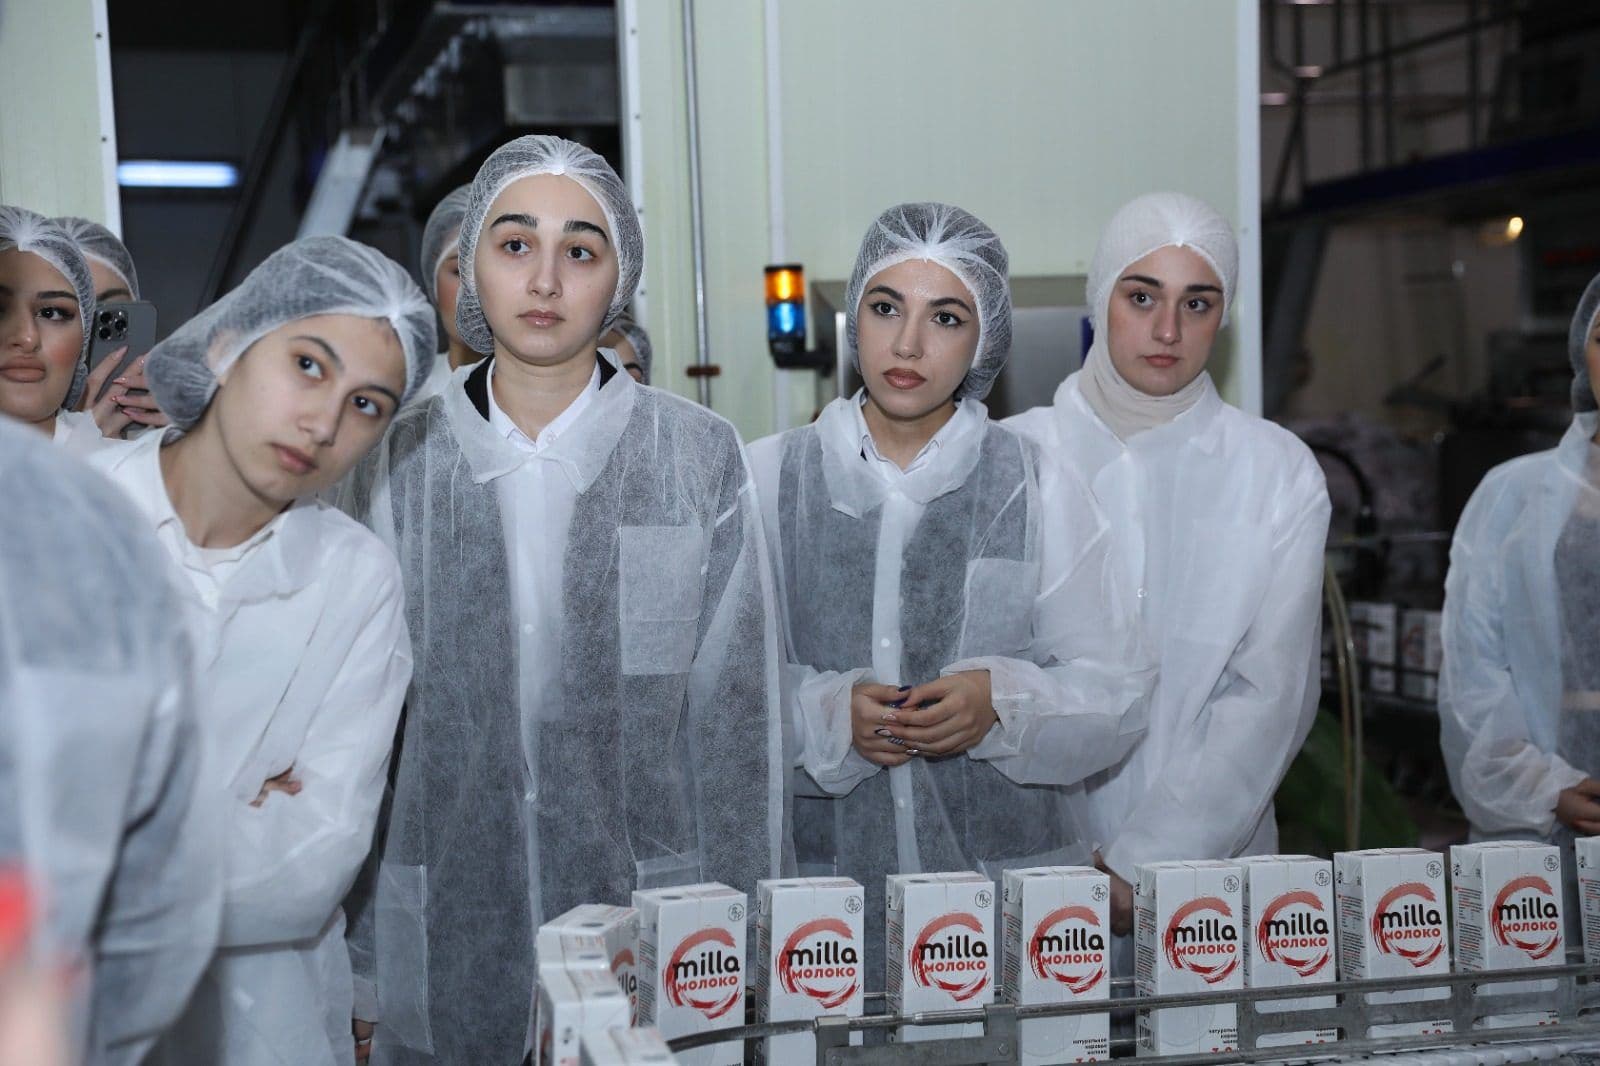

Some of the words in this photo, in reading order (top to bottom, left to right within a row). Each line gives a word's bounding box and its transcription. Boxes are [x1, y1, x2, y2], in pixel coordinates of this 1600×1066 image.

[1379, 904, 1443, 929] milla
[1497, 897, 1559, 921] milla
[1171, 918, 1238, 944] milla
[1265, 912, 1329, 937] milla
[919, 935, 989, 961] milla
[1037, 928, 1105, 953] milla
[672, 950, 740, 980] milla
[786, 941, 858, 967] milla
